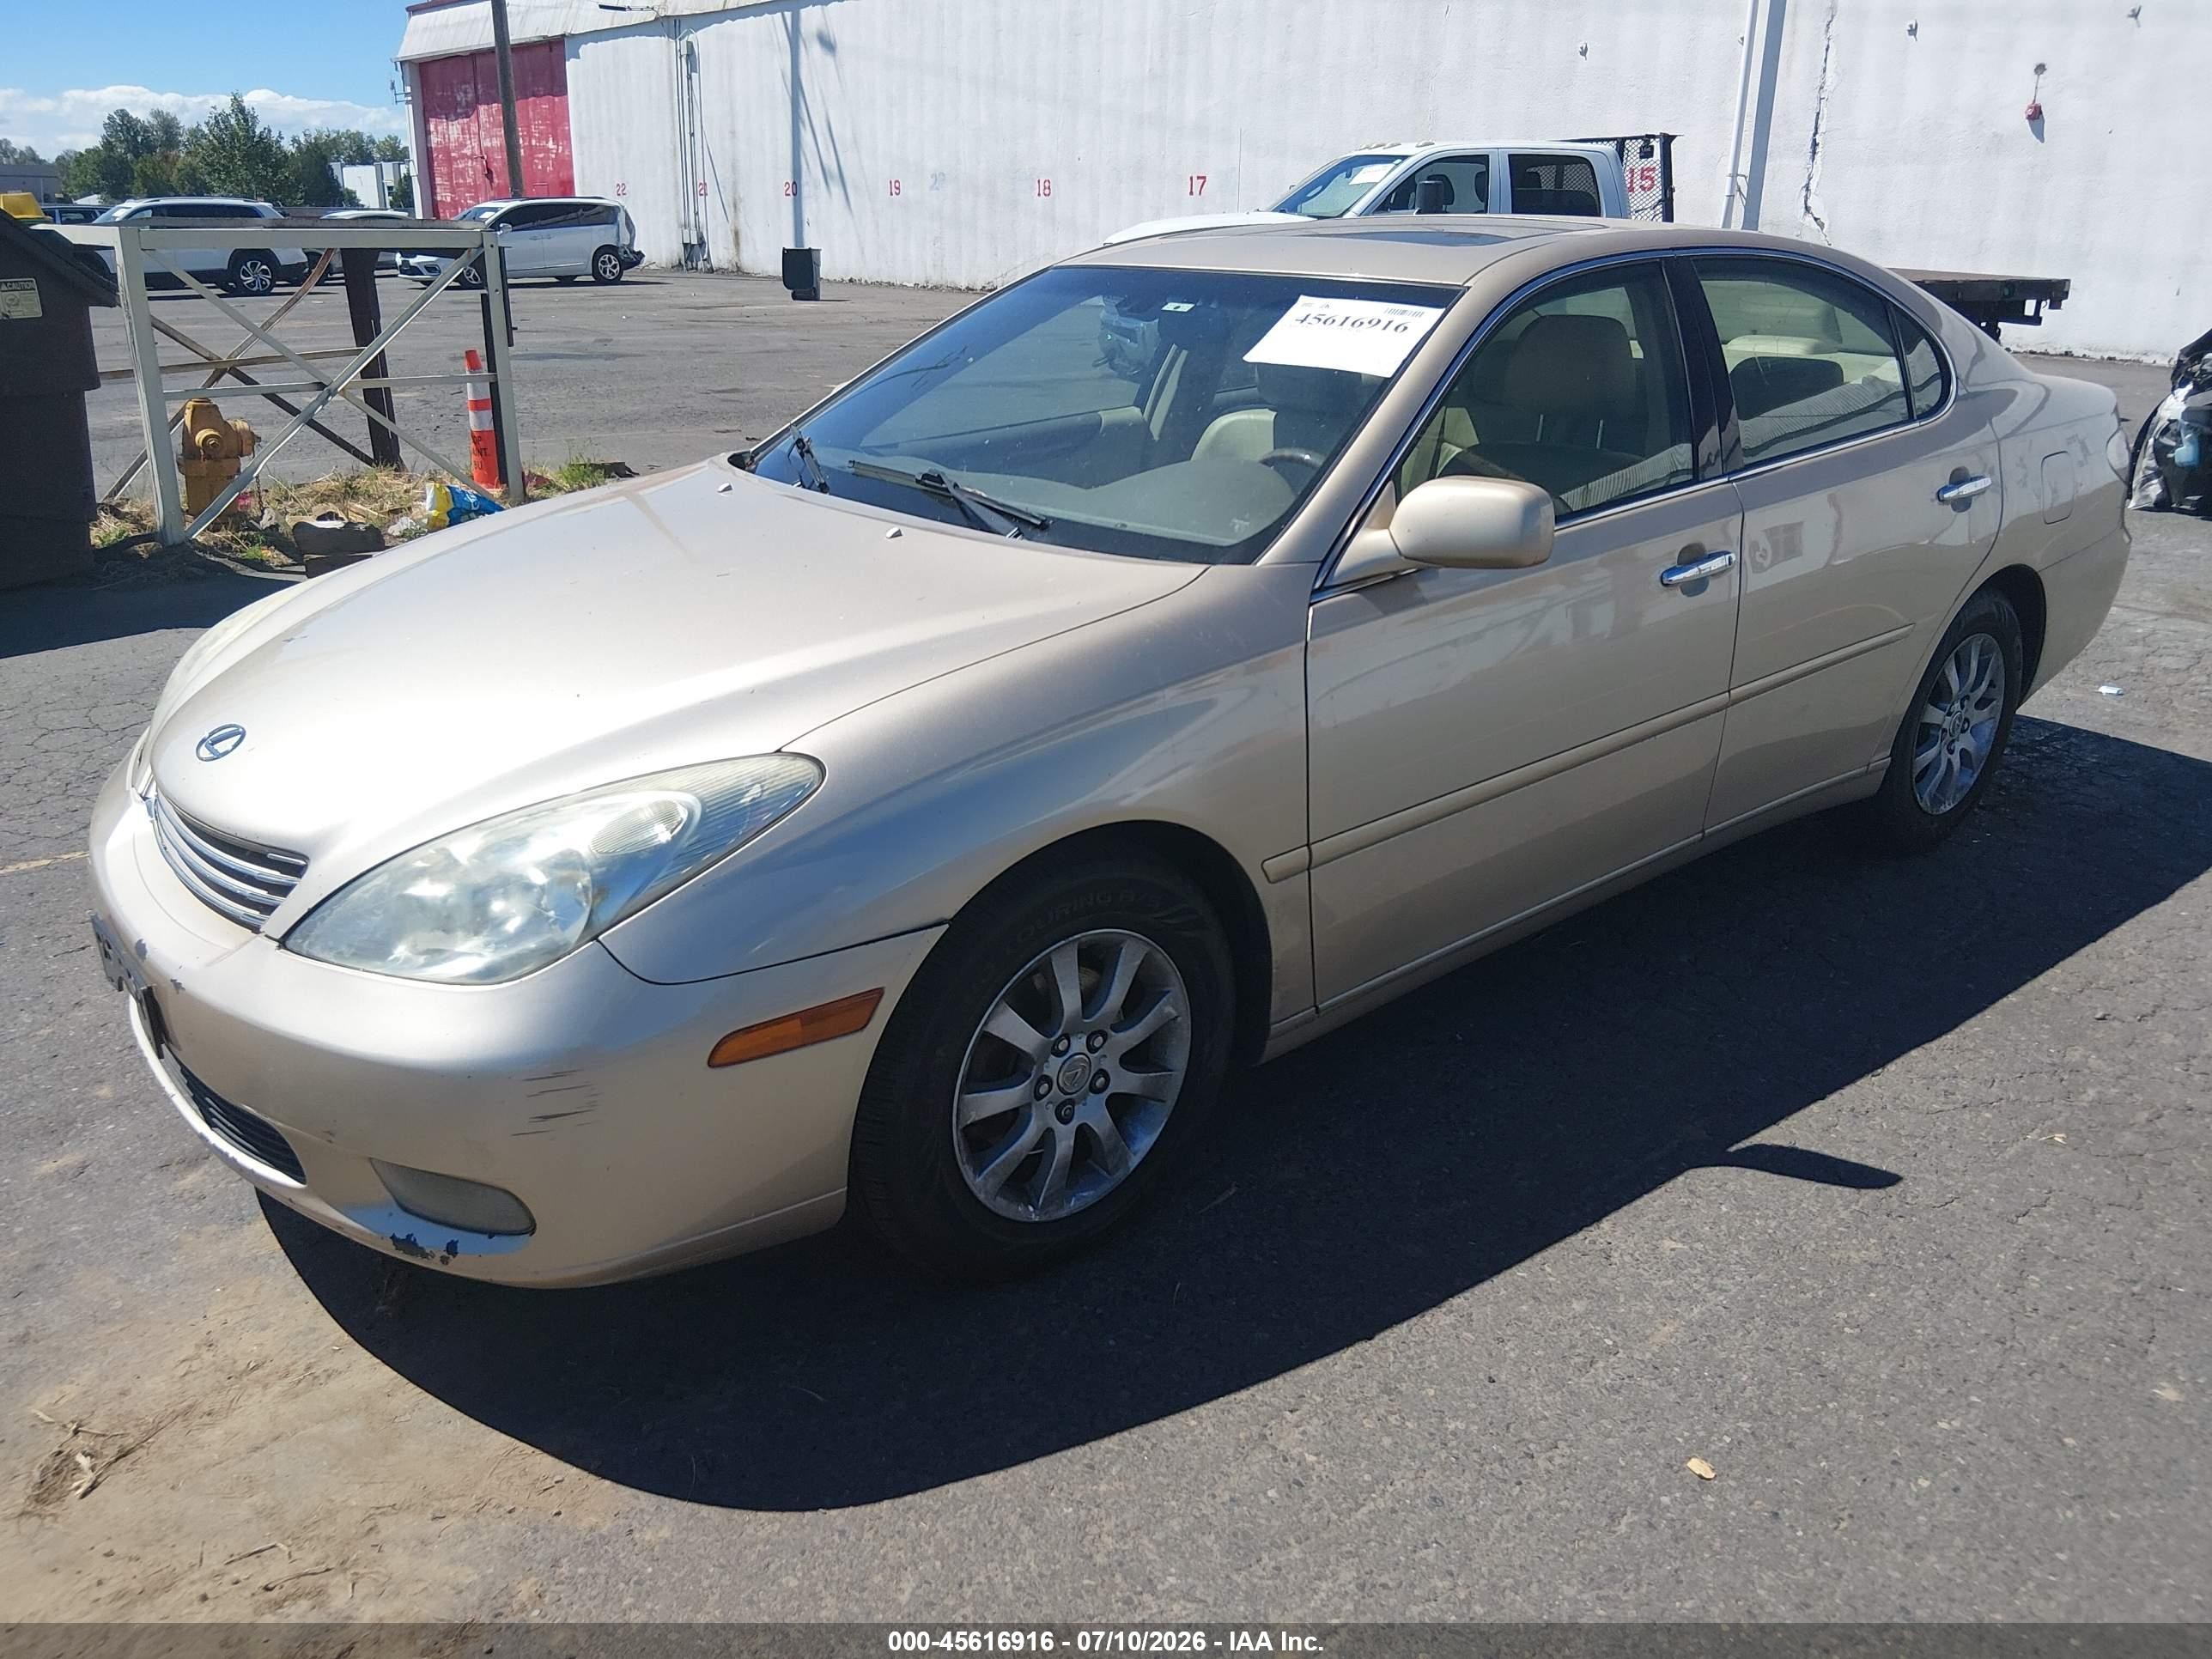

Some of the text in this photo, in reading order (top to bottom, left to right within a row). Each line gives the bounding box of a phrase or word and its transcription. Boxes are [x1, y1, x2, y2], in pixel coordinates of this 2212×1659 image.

[698, 181, 708, 197] 21
[784, 181, 798, 197] 20
[889, 179, 901, 197] 19
[1036, 179, 1051, 197] 18
[1189, 175, 1206, 196] 17
[1627, 167, 1656, 193] 15
[616, 182, 627, 197] 22
[7, 281, 36, 290] CAUTION
[1295, 313, 1411, 335] 45616916
